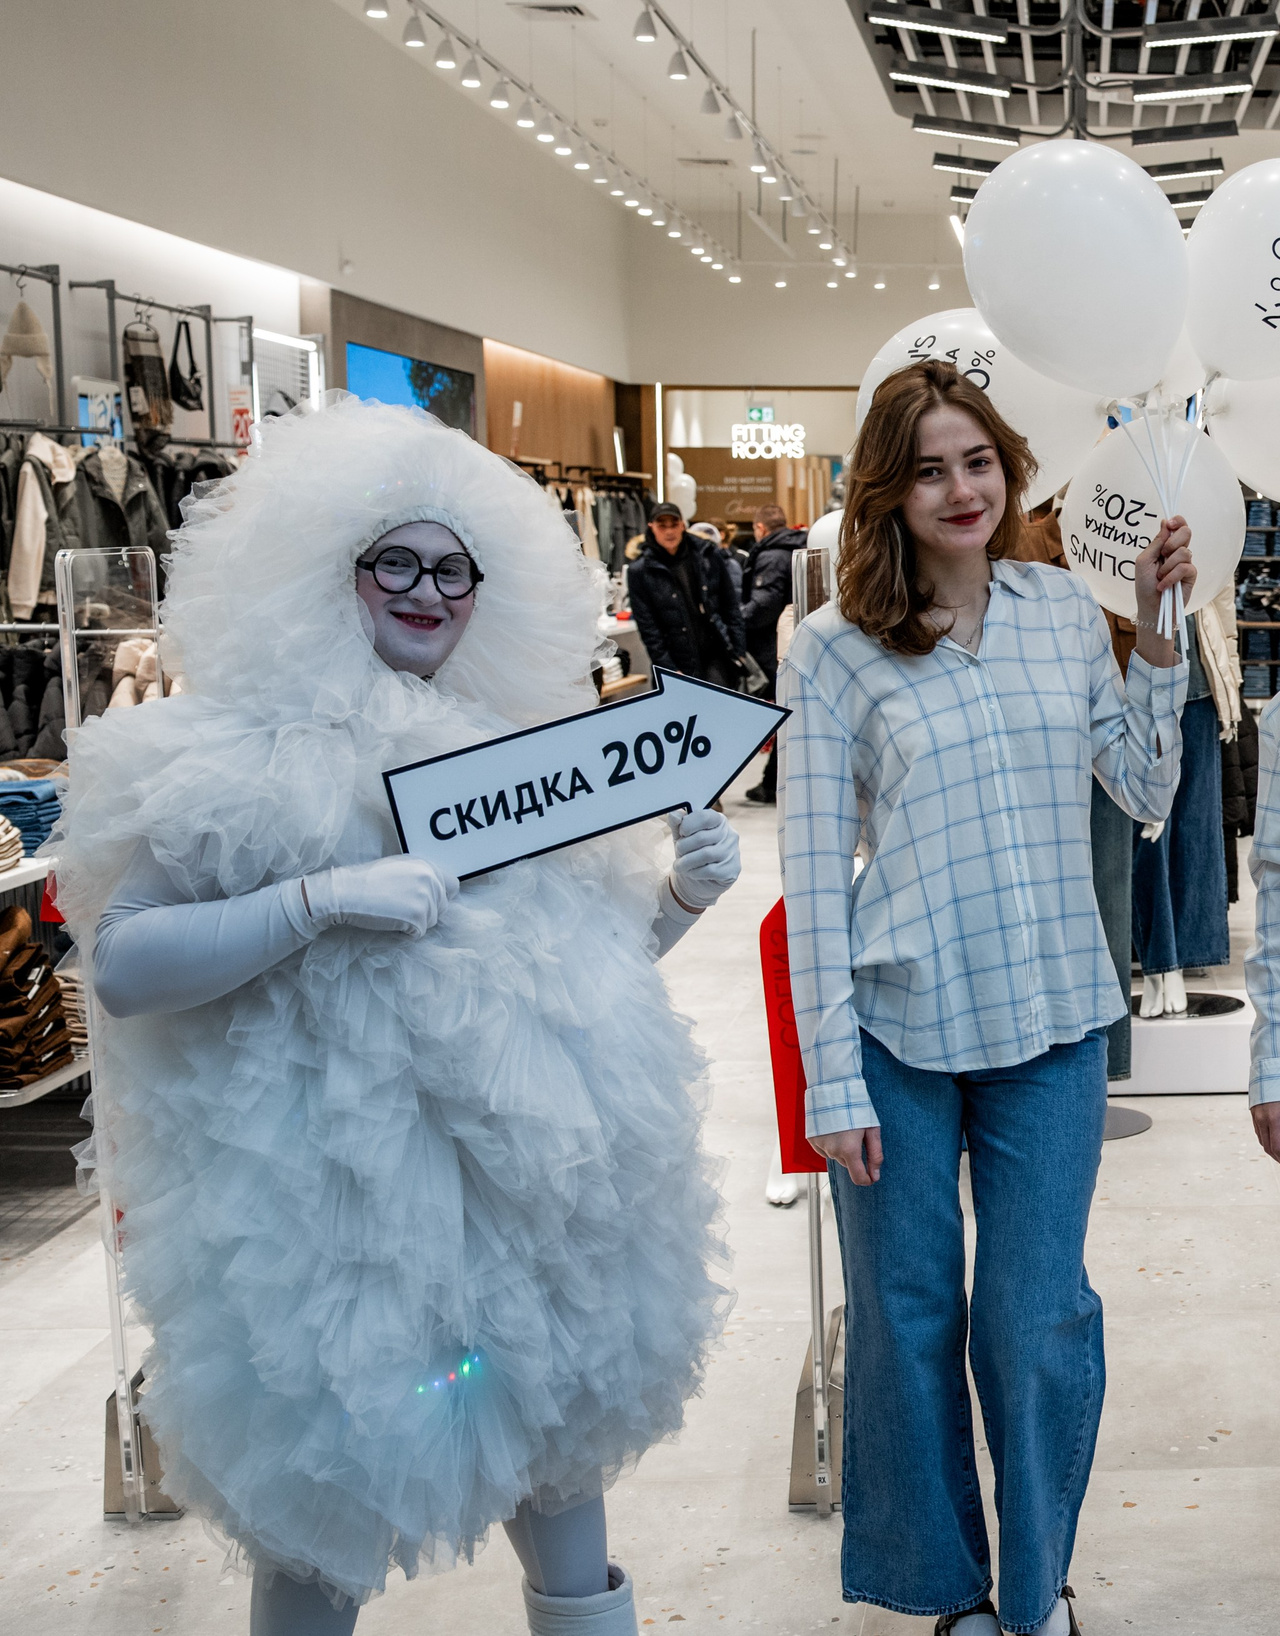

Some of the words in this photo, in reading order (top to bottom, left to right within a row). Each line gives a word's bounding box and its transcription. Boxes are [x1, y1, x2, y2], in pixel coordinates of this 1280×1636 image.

[731, 423, 806, 442] FITTING
[731, 441, 806, 460] ROOMS
[1092, 483, 1158, 527] -20%
[1085, 514, 1152, 550] СКИДКА
[1070, 533, 1136, 582] OLIN'S
[428, 766, 595, 842] СКИДКА
[601, 714, 712, 788] 20%
